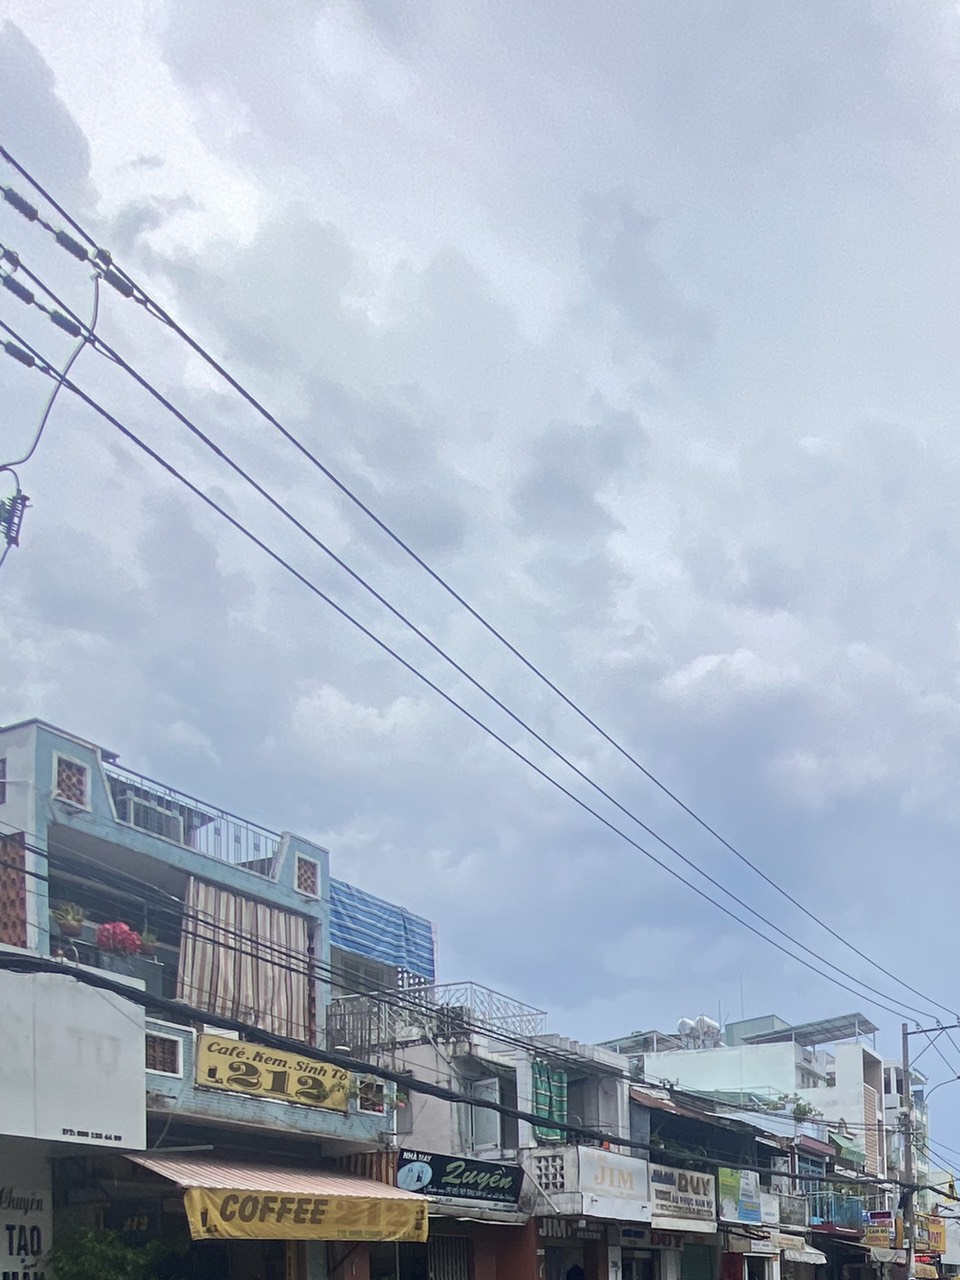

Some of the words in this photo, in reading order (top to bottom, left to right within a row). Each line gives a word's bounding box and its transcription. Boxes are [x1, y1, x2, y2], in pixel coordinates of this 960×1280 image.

[294, 1060, 327, 1077] Sinh
[226, 1061, 329, 1103] 212
[594, 1166, 634, 1191] JIM
[678, 1173, 711, 1196] DUY
[220, 1193, 329, 1224] COFFEE
[335, 1199, 411, 1228] 212
